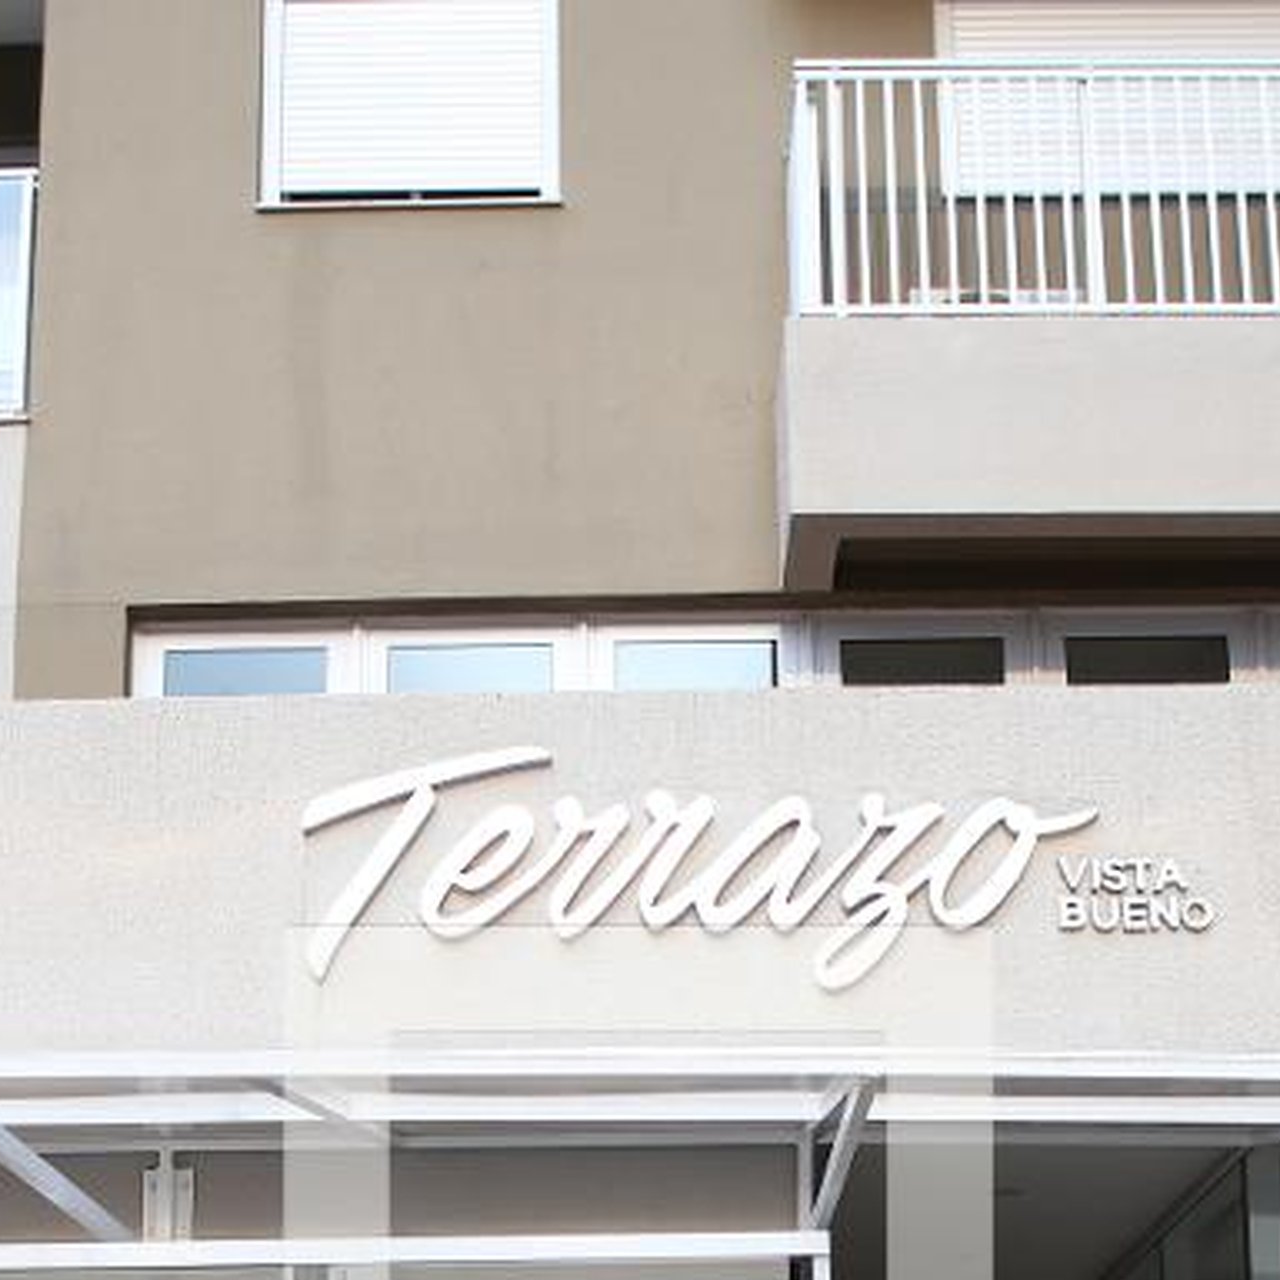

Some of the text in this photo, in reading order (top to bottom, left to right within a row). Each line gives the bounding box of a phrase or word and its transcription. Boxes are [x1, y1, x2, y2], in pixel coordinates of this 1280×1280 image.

[302, 744, 1099, 990] Terrazo
[1056, 855, 1188, 894] VISTA
[1058, 896, 1216, 934] BUENO
